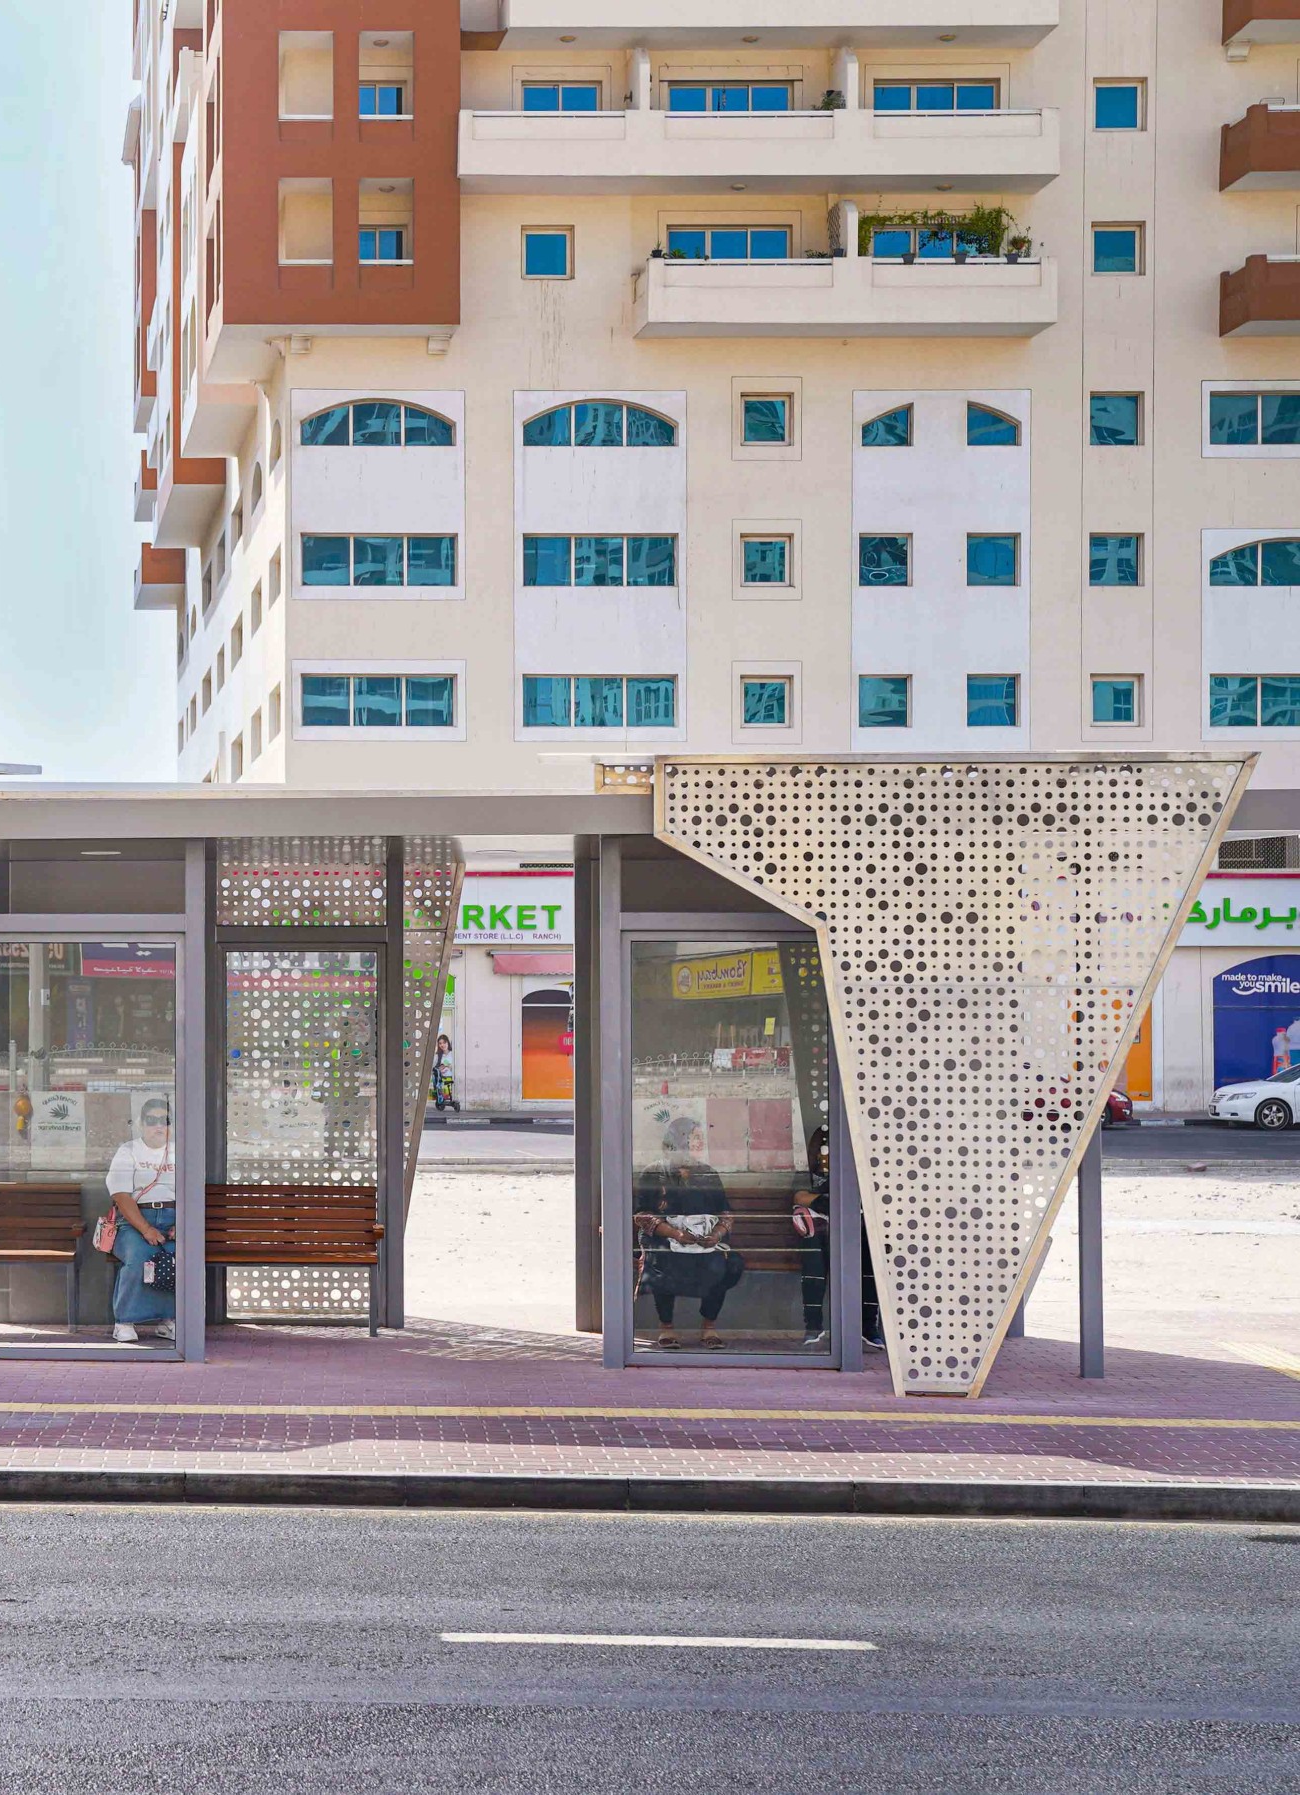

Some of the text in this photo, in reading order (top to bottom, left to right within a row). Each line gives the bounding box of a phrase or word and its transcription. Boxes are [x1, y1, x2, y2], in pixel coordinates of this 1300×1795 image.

[455, 904, 562, 931] RKET
[473, 932, 498, 940] STORE
[500, 932, 524, 941] (L.L.C)
[1221, 973, 1282, 982] made to make
[1239, 977, 1300, 994] you smile
